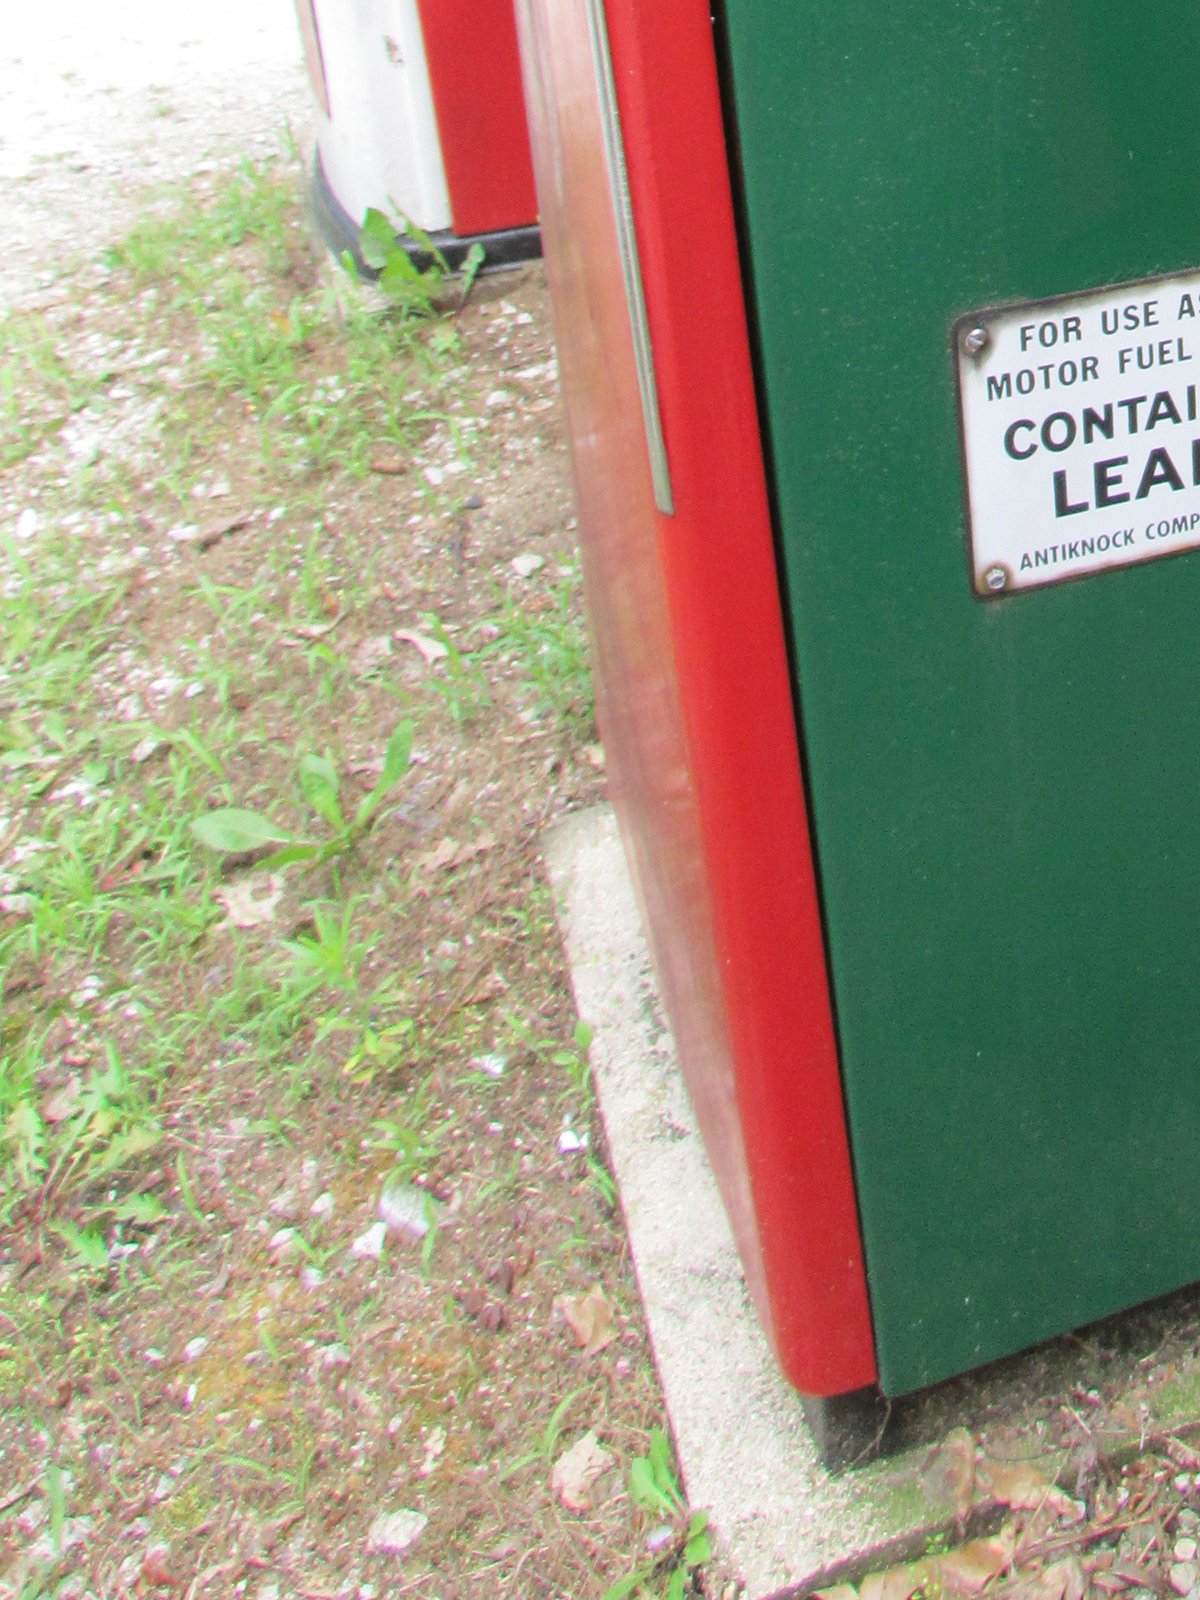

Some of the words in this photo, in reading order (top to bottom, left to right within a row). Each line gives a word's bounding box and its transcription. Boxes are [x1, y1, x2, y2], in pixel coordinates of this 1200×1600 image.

[1019, 316, 1083, 352] FOR
[1100, 301, 1160, 336] USE
[986, 356, 1100, 402] MOTOR
[1118, 337, 1193, 375] FUEL
[1019, 527, 1136, 571] ANTIKNOCK
